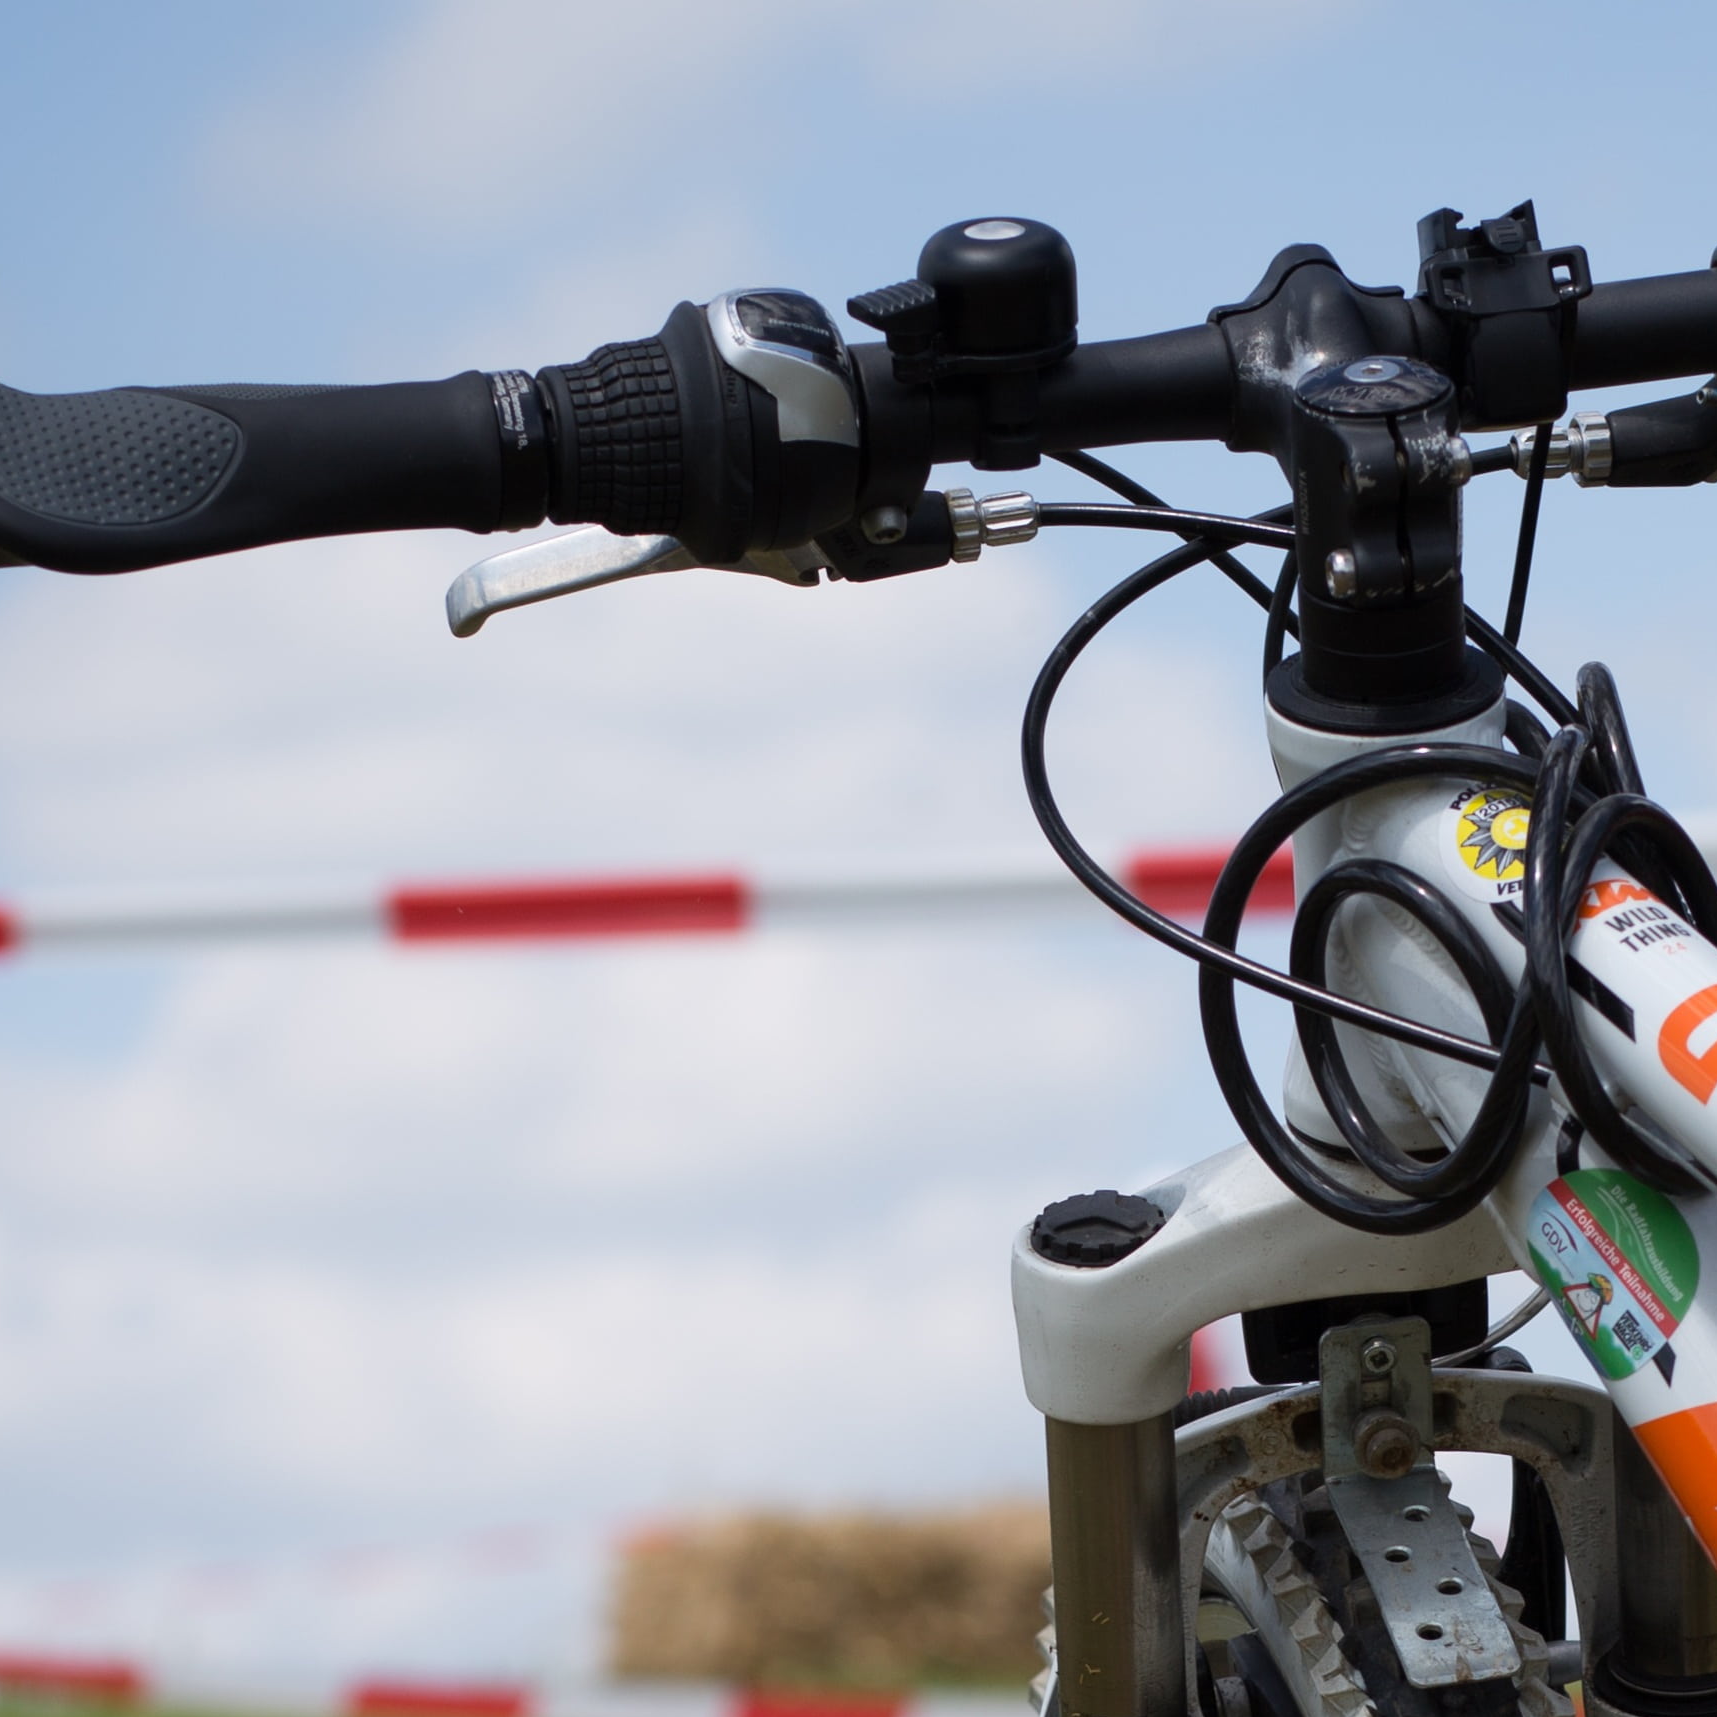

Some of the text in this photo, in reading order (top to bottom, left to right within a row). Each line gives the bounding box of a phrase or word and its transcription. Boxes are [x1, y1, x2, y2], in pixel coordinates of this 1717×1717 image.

[1605, 906, 1668, 933] WILD
[1619, 922, 1691, 953] THING
[1540, 1221, 1569, 1254] GDV
[1609, 1184, 1684, 1303] Die Radfahrausbildung
[1565, 1197, 1666, 1324] Erfolgreiche Teilnahme
